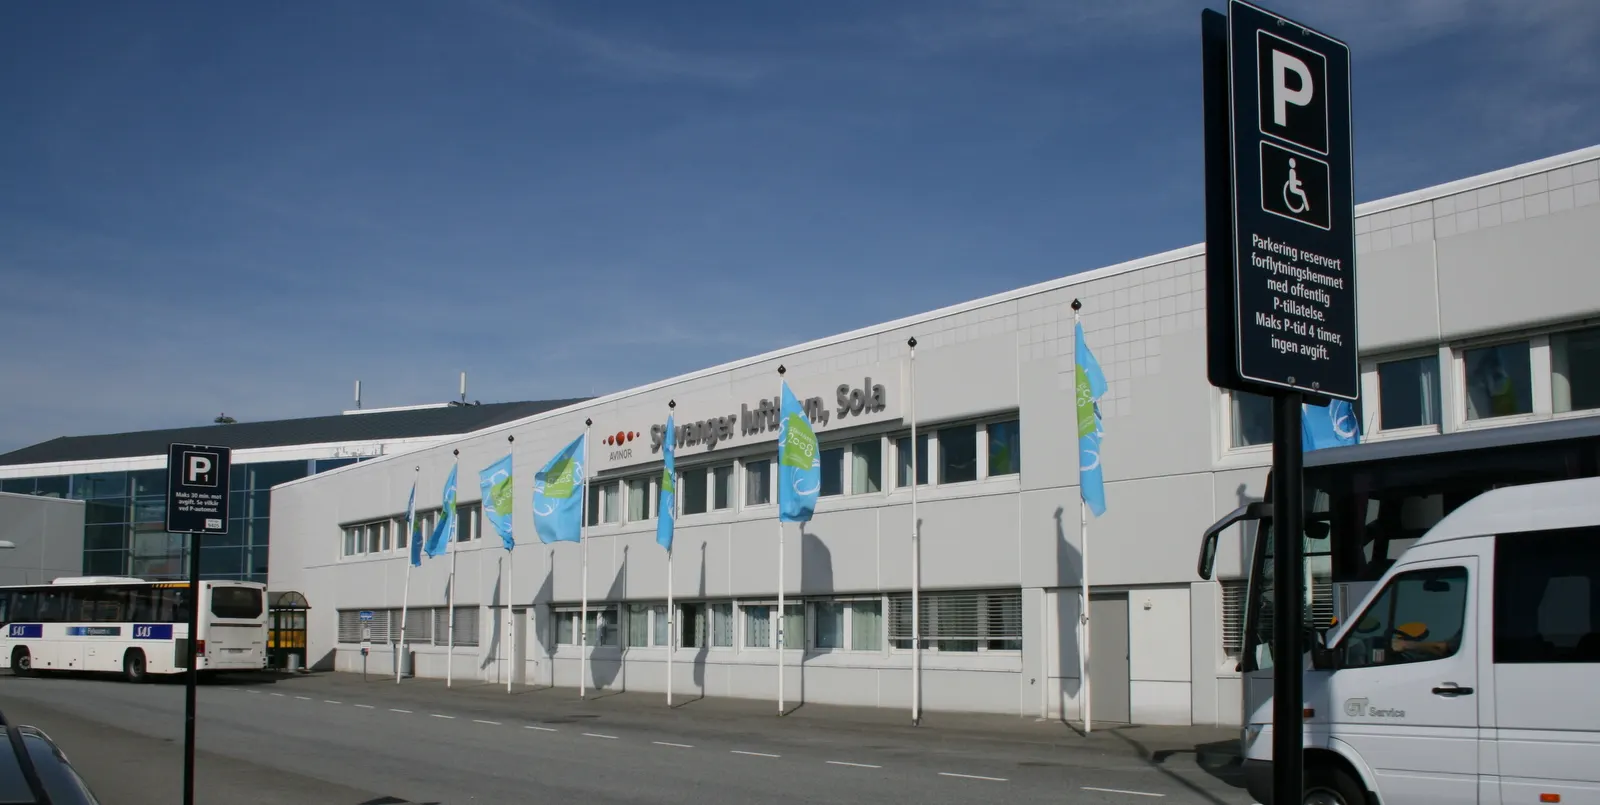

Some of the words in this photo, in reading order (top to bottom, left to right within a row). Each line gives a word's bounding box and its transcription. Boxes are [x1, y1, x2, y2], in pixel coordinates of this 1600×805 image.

[1271, 48, 1314, 127] P
[1252, 233, 1298, 261] Parkering
[1300, 249, 1341, 271] reservert
[1251, 251, 1344, 290] forflytningshemmet
[1267, 279, 1288, 293] med
[1290, 283, 1330, 307] offentlig
[1273, 296, 1326, 322] P-tillatelse.
[1255, 311, 1282, 330] Maks
[1284, 318, 1306, 336] P-tid
[1308, 324, 1315, 338] 4
[1316, 326, 1343, 347] timer,
[1271, 334, 1298, 354] ingen
[1300, 344, 1330, 361] avgift.
[650, 414, 737, 454] Stvanger
[741, 396, 829, 437] luftvn,
[836, 376, 886, 420] Sola
[609, 448, 633, 461] AVINOR
[788, 432, 814, 457] 2008
[11, 626, 26, 636] SAS
[136, 626, 152, 637] SAS
[1344, 697, 1369, 717] GT
[1369, 706, 1406, 718] Service
